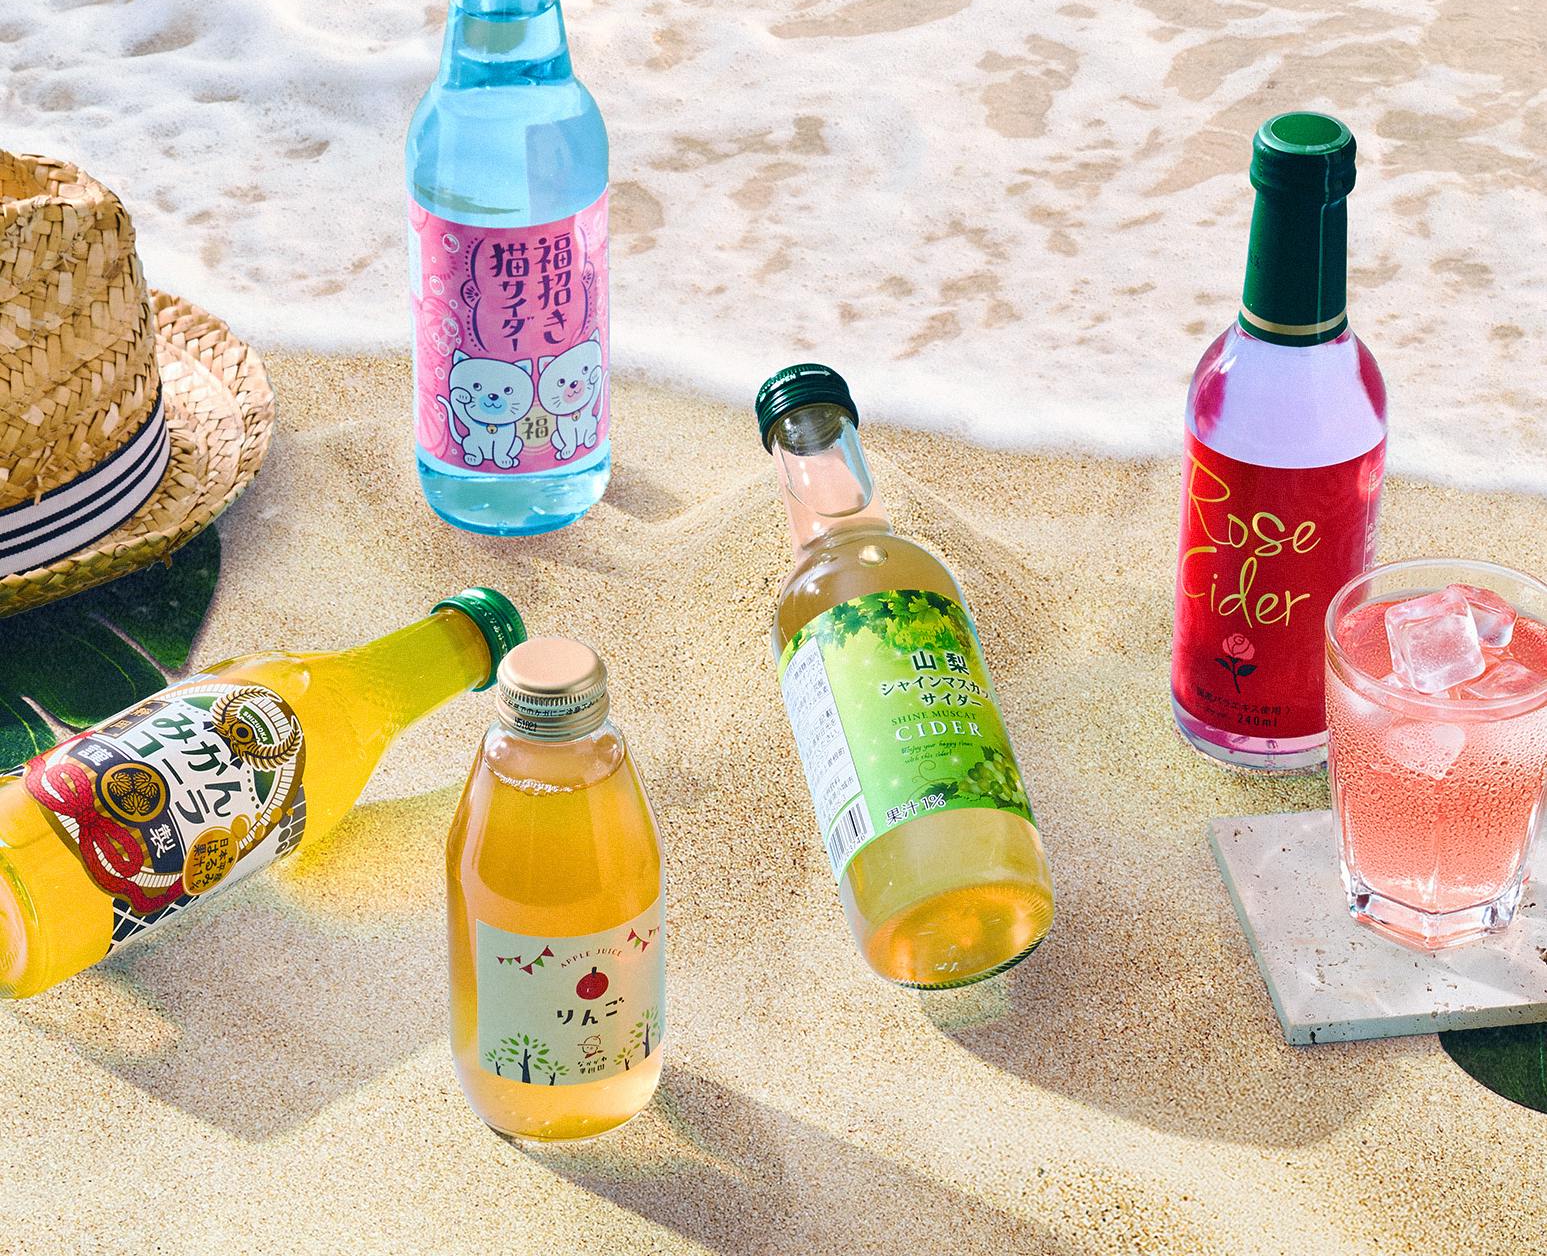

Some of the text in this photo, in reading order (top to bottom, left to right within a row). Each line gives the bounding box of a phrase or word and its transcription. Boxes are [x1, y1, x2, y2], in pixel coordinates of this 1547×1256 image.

[489, 242, 535, 352] 猫サイダー
[533, 232, 573, 345] 福招き
[521, 415, 549, 440] 福
[1187, 449, 1321, 556] Rose
[1181, 546, 1311, 629] Cider
[912, 650, 970, 675] 山梨
[881, 676, 989, 699] シャインマスカッ
[921, 693, 982, 706] サイダー
[243, 711, 269, 742] SHIZUOKA
[891, 710, 977, 726] SHINE MUSCAT
[895, 721, 983, 742] CIDER
[1237, 714, 1278, 728] 240ml
[122, 730, 205, 824] コーラ
[151, 712, 242, 818] みかん
[189, 844, 207, 891] 果汁1%
[202, 839, 219, 888] はるみ
[560, 947, 622, 969] APPLE JUICE
[556, 996, 625, 1026] りんご
